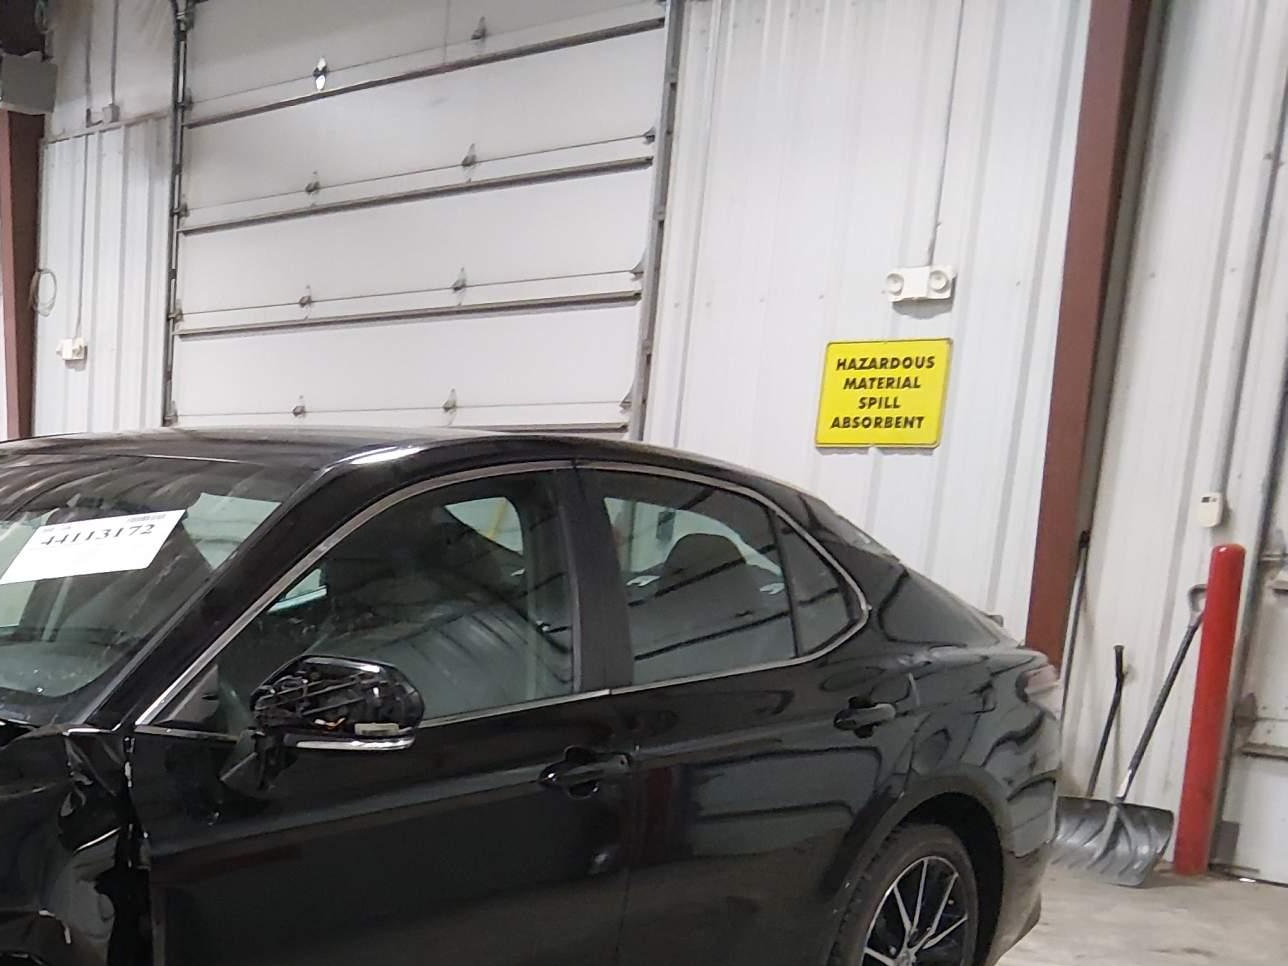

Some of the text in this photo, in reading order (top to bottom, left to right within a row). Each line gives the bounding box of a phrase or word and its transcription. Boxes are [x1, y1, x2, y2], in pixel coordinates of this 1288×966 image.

[836, 356, 935, 371] HAZARDOUS
[843, 377, 921, 390] MATERIAL
[858, 396, 901, 409] SPILL
[830, 416, 925, 429] ABSORBENT
[41, 523, 156, 546] 44113172
